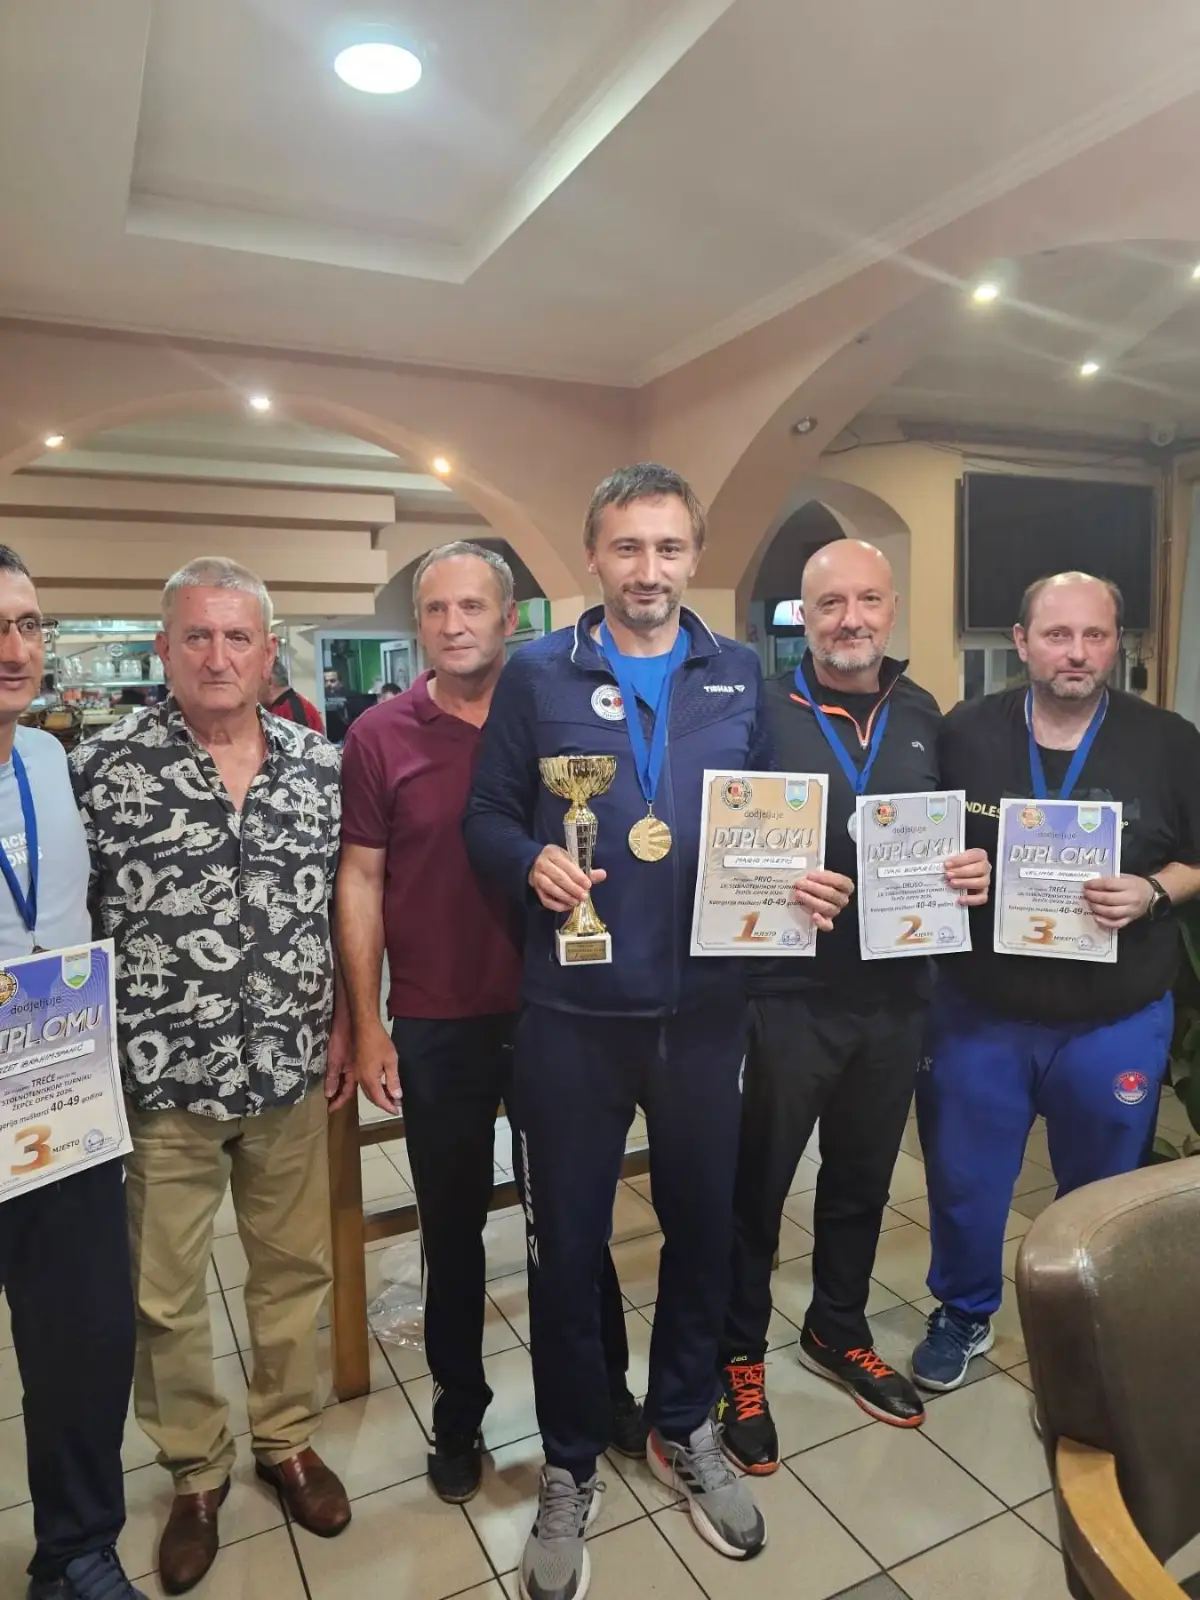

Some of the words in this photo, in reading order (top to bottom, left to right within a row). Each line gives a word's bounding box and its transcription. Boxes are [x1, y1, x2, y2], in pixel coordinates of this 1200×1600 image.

[712, 827, 815, 849] DIPLOMU
[867, 837, 955, 861] DIPLOMU
[1009, 844, 1110, 865] DIPLOMU
[762, 898, 786, 906] 40-49
[1058, 906, 1083, 914] 40-49
[732, 911, 769, 943] 1
[896, 914, 931, 945] 2
[1022, 916, 1057, 945] 3
[50, 1095, 80, 1113] 40-49
[11, 1124, 52, 1175] 3
